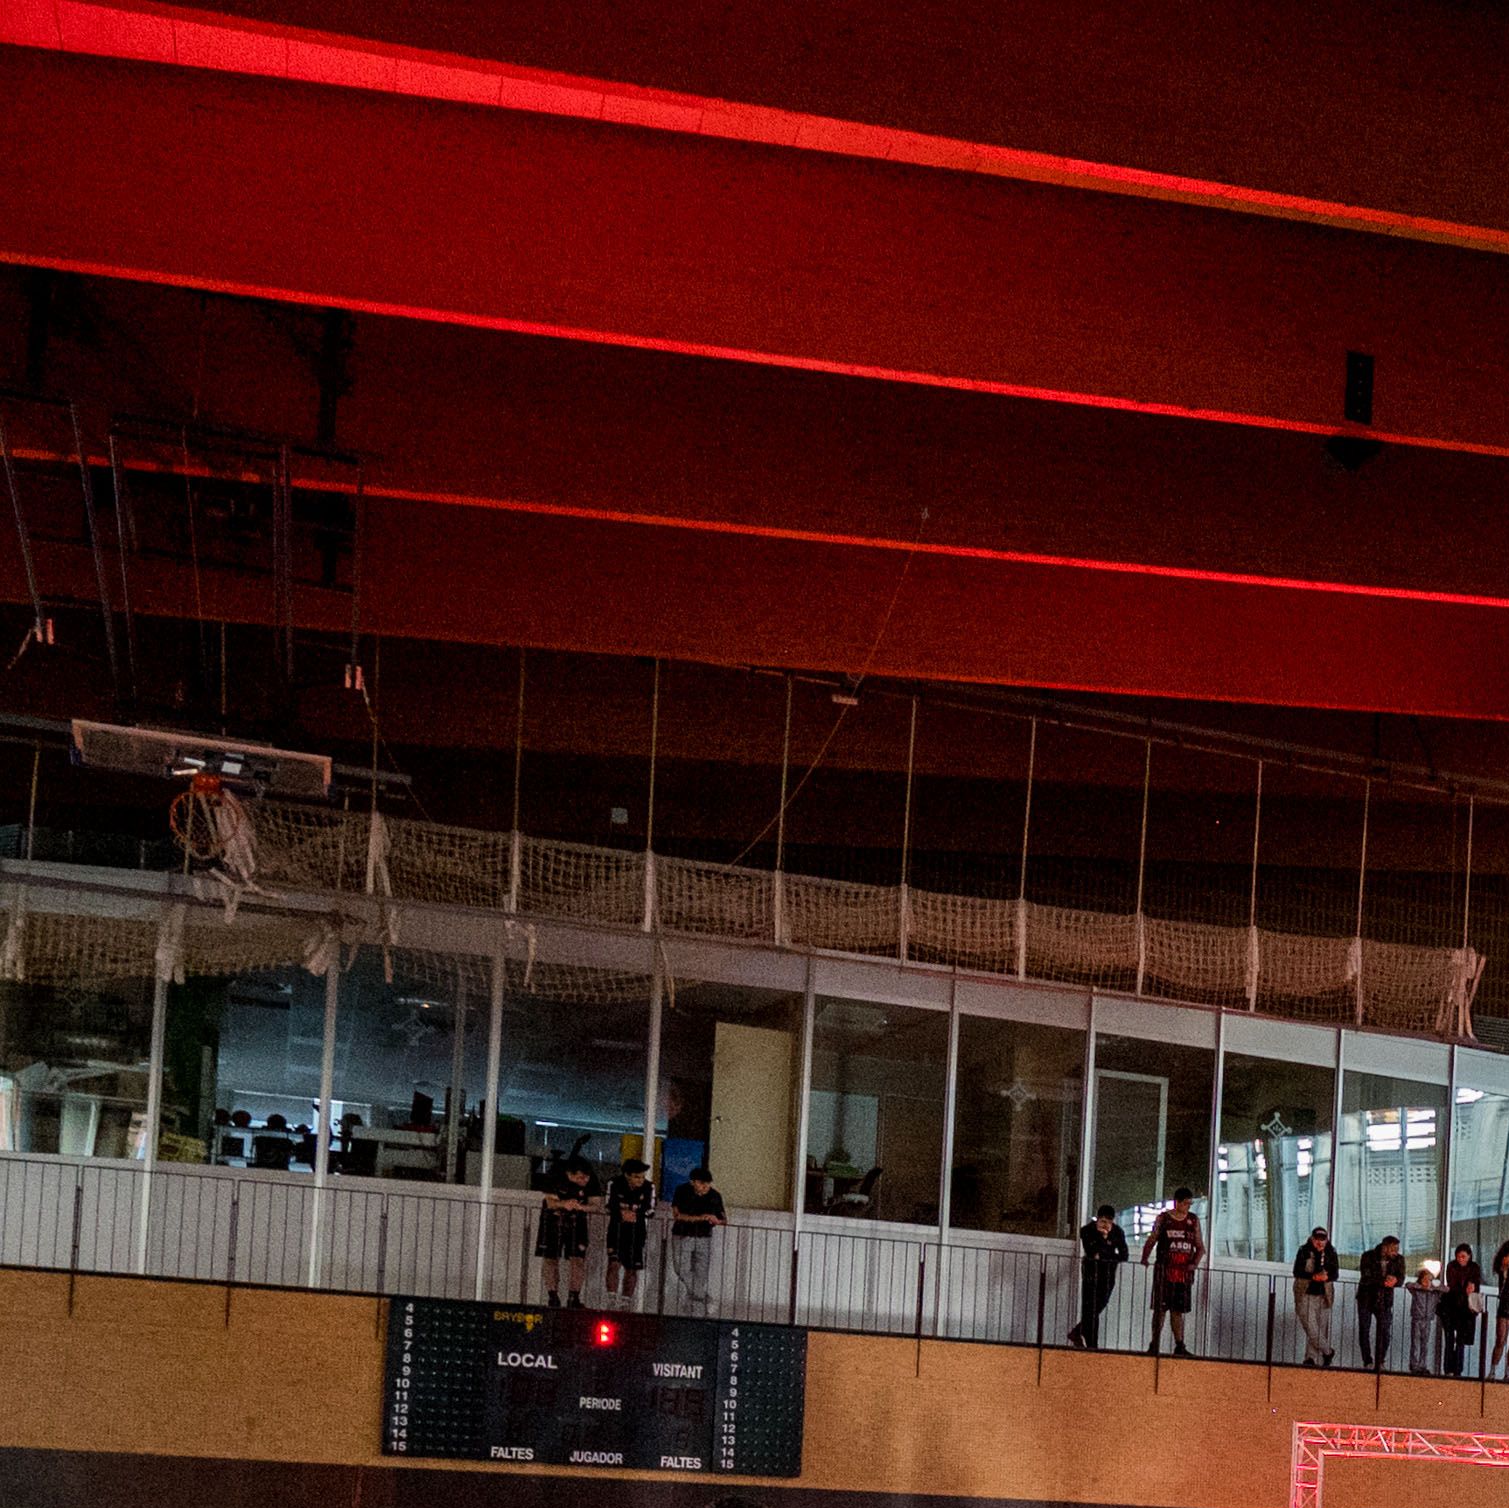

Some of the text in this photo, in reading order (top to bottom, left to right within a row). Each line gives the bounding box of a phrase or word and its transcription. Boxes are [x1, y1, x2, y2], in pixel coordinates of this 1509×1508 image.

[406, 1303, 413, 1313] 4
[405, 1316, 413, 1325] 5
[404, 1329, 413, 1338] 6
[731, 1328, 739, 1337] 4
[404, 1341, 412, 1350] 7
[731, 1340, 739, 1349] 5
[403, 1353, 411, 1363] 8
[498, 1352, 558, 1369] LOCAL
[731, 1352, 738, 1361] 6
[402, 1366, 411, 1376] 9
[652, 1363, 703, 1379] VISITANT
[731, 1364, 738, 1373] 7
[395, 1378, 410, 1388] 10
[730, 1376, 737, 1385] 8
[395, 1391, 408, 1400] 11
[730, 1388, 737, 1397] 9
[579, 1397, 622, 1410] PERIODE
[723, 1400, 736, 1409] 10
[394, 1404, 409, 1414] 12
[393, 1416, 408, 1426] 13
[723, 1412, 734, 1421] 11
[722, 1424, 735, 1433] 12
[392, 1429, 407, 1438] 14
[722, 1436, 735, 1445] 13
[392, 1441, 406, 1451] 15
[491, 1446, 534, 1460] FALTES
[722, 1448, 734, 1456] 14
[569, 1451, 623, 1464] JUGADOR
[660, 1456, 702, 1469] FALTES
[721, 1460, 734, 1469] 15
